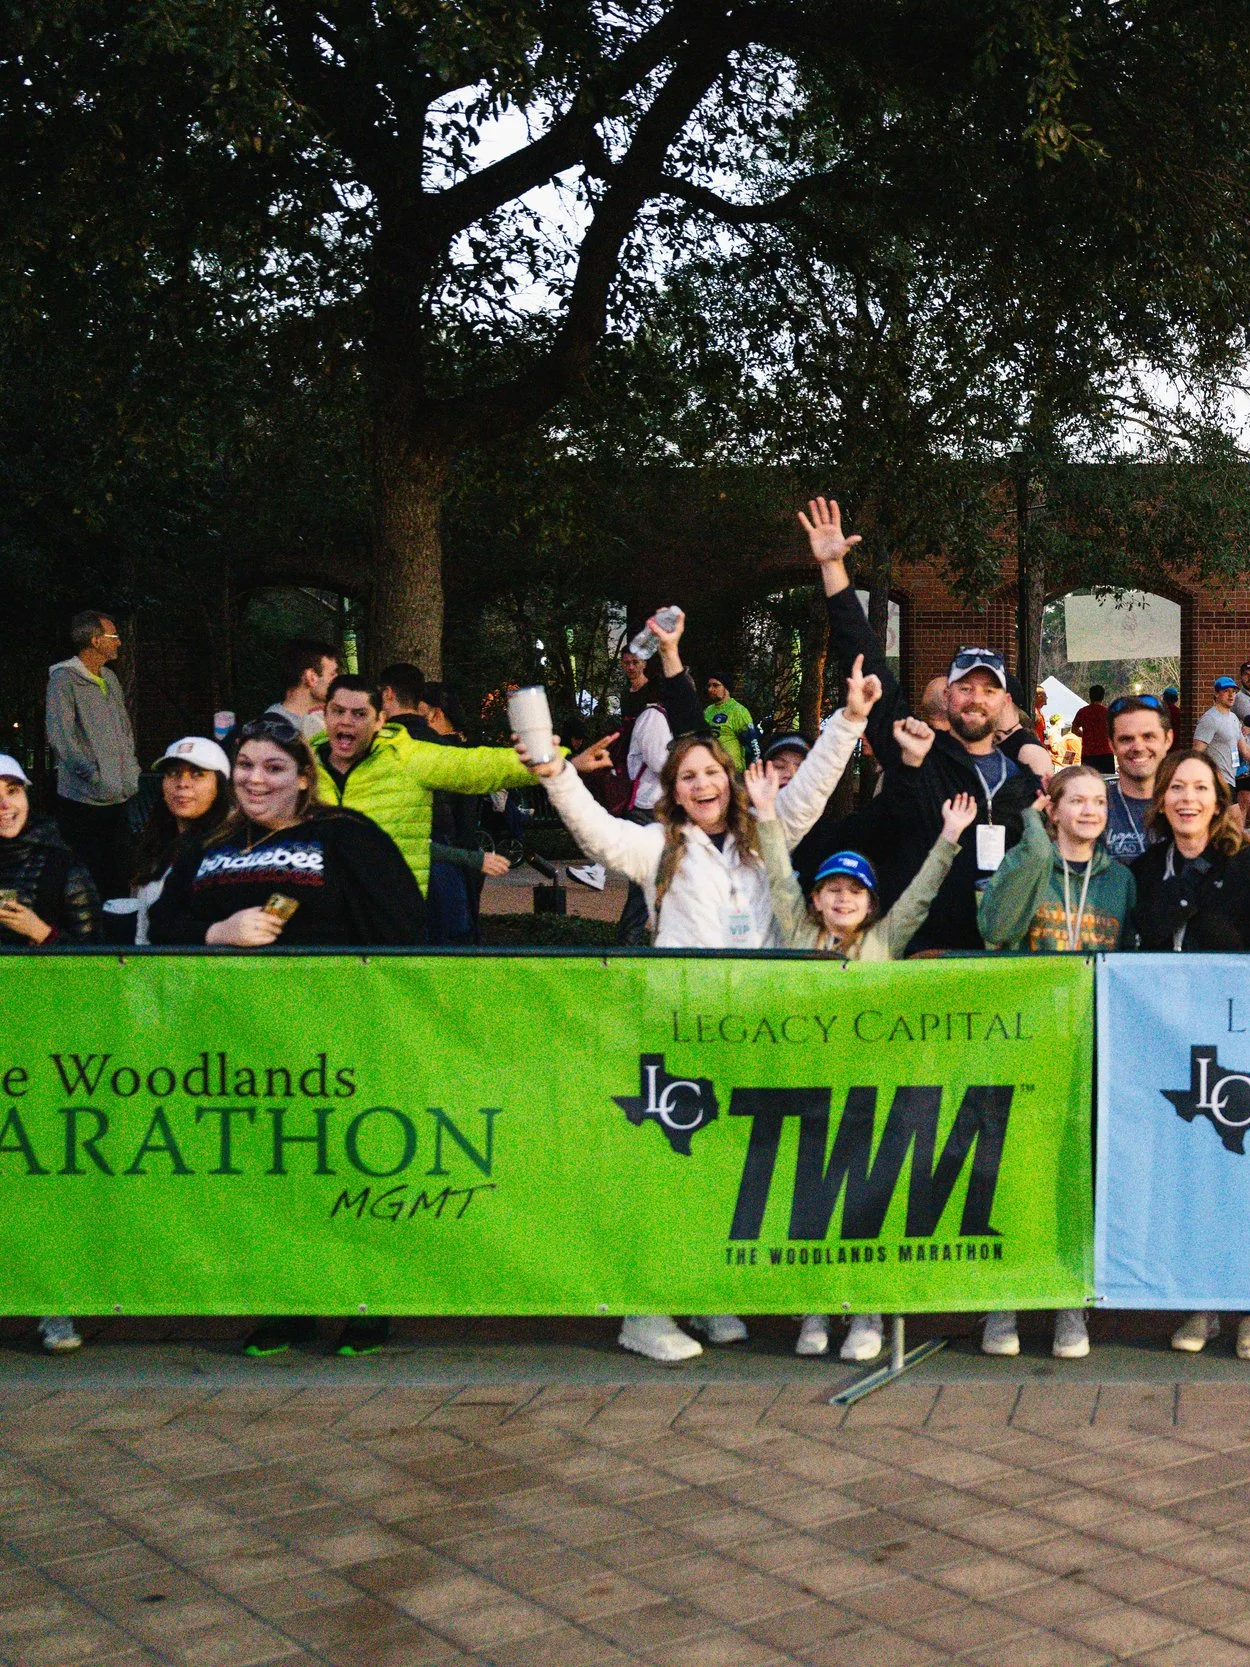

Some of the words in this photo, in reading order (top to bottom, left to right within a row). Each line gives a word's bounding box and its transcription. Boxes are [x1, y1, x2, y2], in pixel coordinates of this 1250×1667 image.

[673, 1011, 838, 1043] LEGACY
[854, 1010, 1033, 1042] CAPITAL
[50, 1052, 356, 1099] Woodlands
[645, 1065, 704, 1130] LC
[728, 1085, 1014, 1241] TWM
[330, 1184, 498, 1222] MGMT
[725, 1247, 757, 1265] THE
[770, 1246, 887, 1265] WOODLANDS
[898, 1243, 1003, 1262] MARATHON
